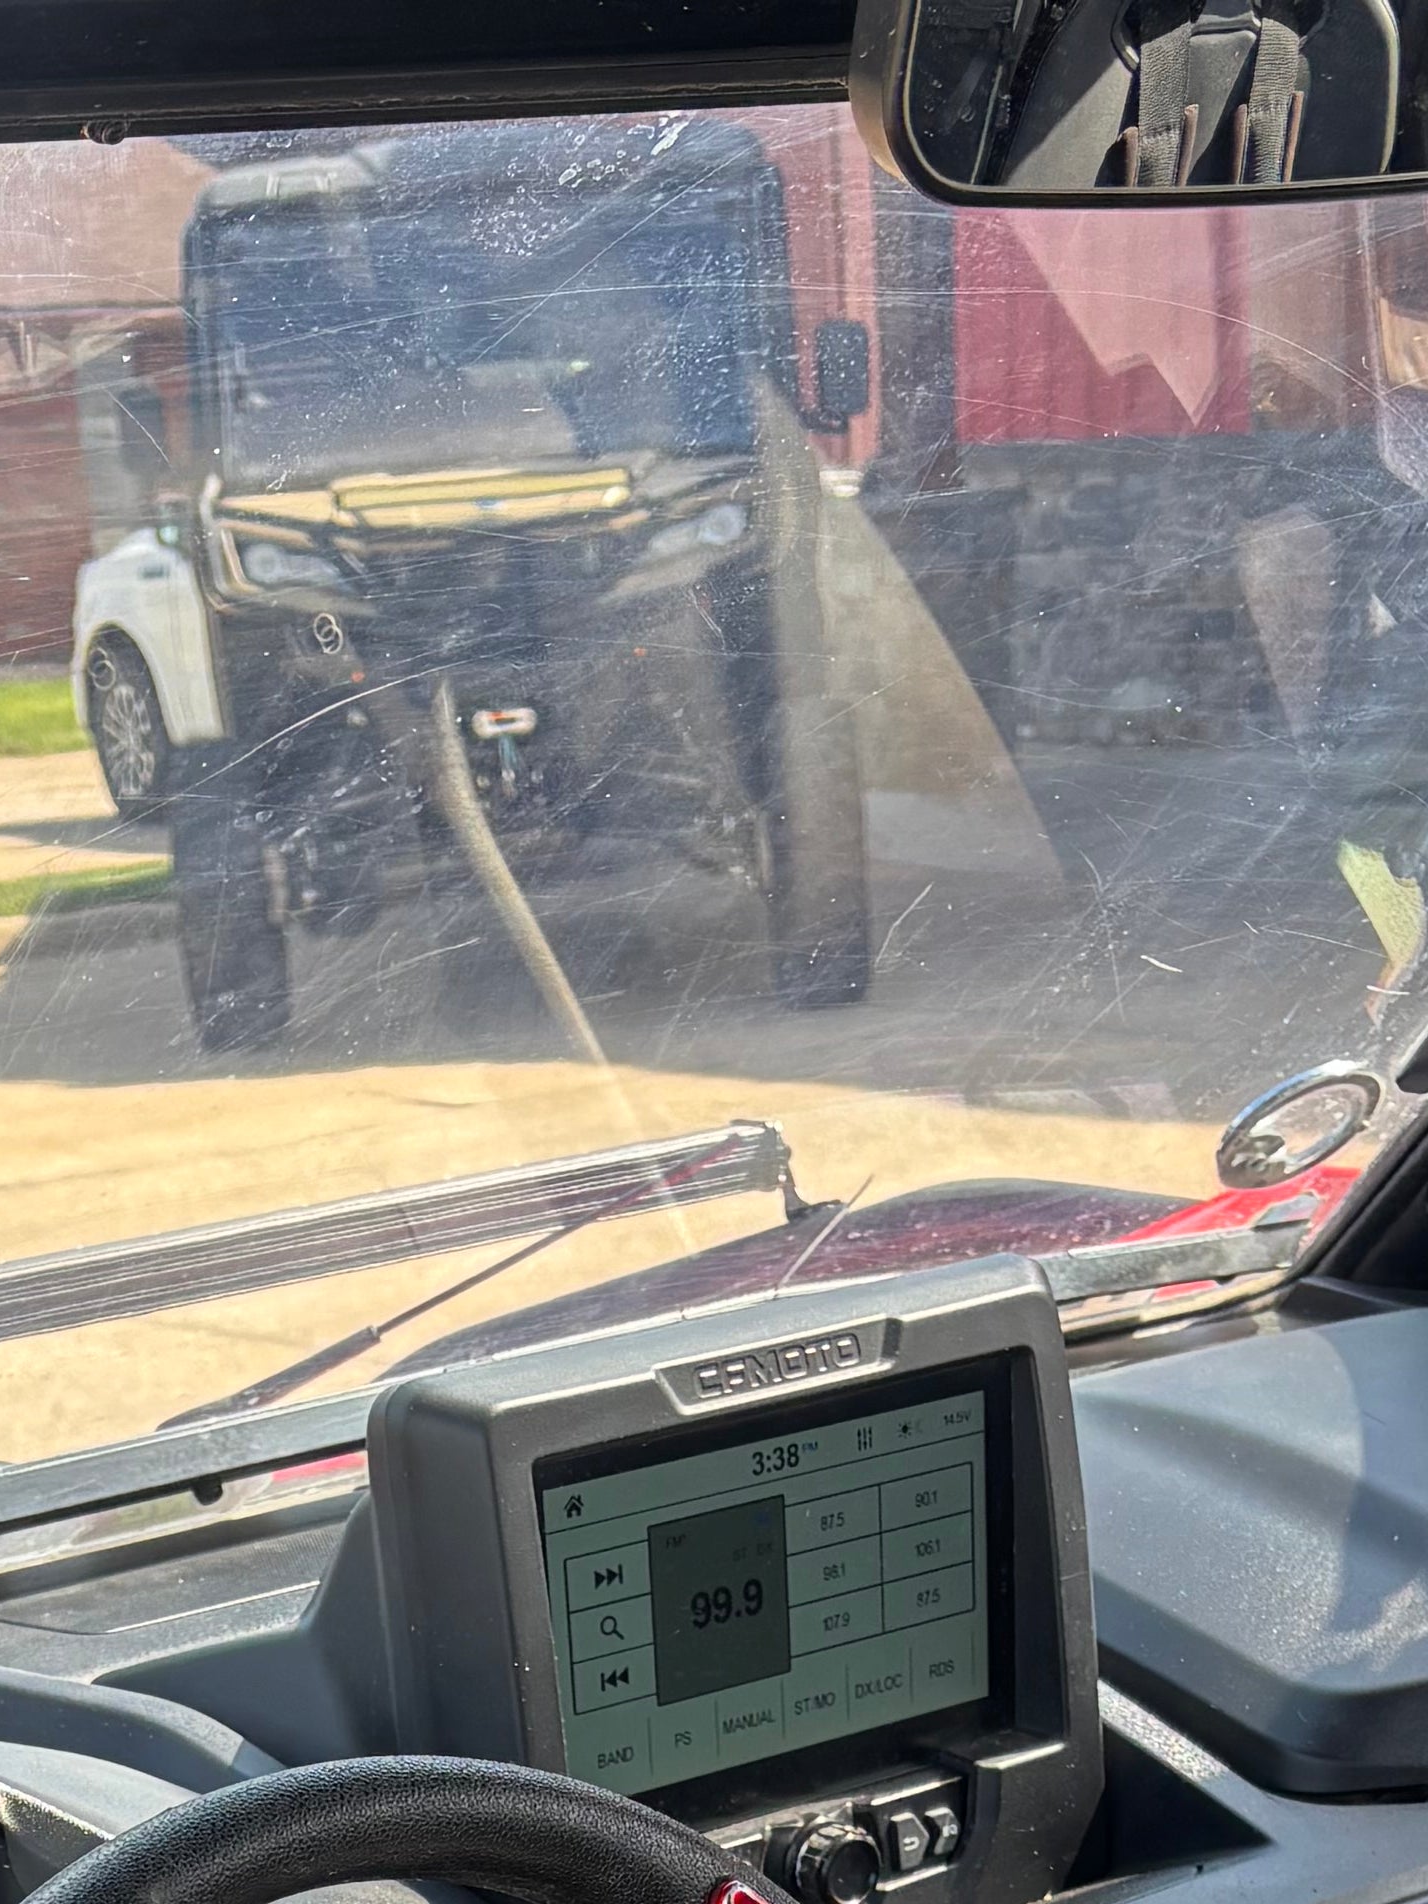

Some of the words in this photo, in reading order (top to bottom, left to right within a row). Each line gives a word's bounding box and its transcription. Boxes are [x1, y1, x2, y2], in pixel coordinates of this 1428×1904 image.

[694, 1332, 861, 1398] CFMOTO
[752, 1442, 800, 1476] 3:38
[820, 1512, 845, 1531] 87.5
[691, 1578, 763, 1629] 99.9
[597, 1747, 634, 1768] BAND
[674, 1732, 692, 1748] PS
[722, 1711, 776, 1733] MANUAL
[929, 1660, 955, 1679] RDS
